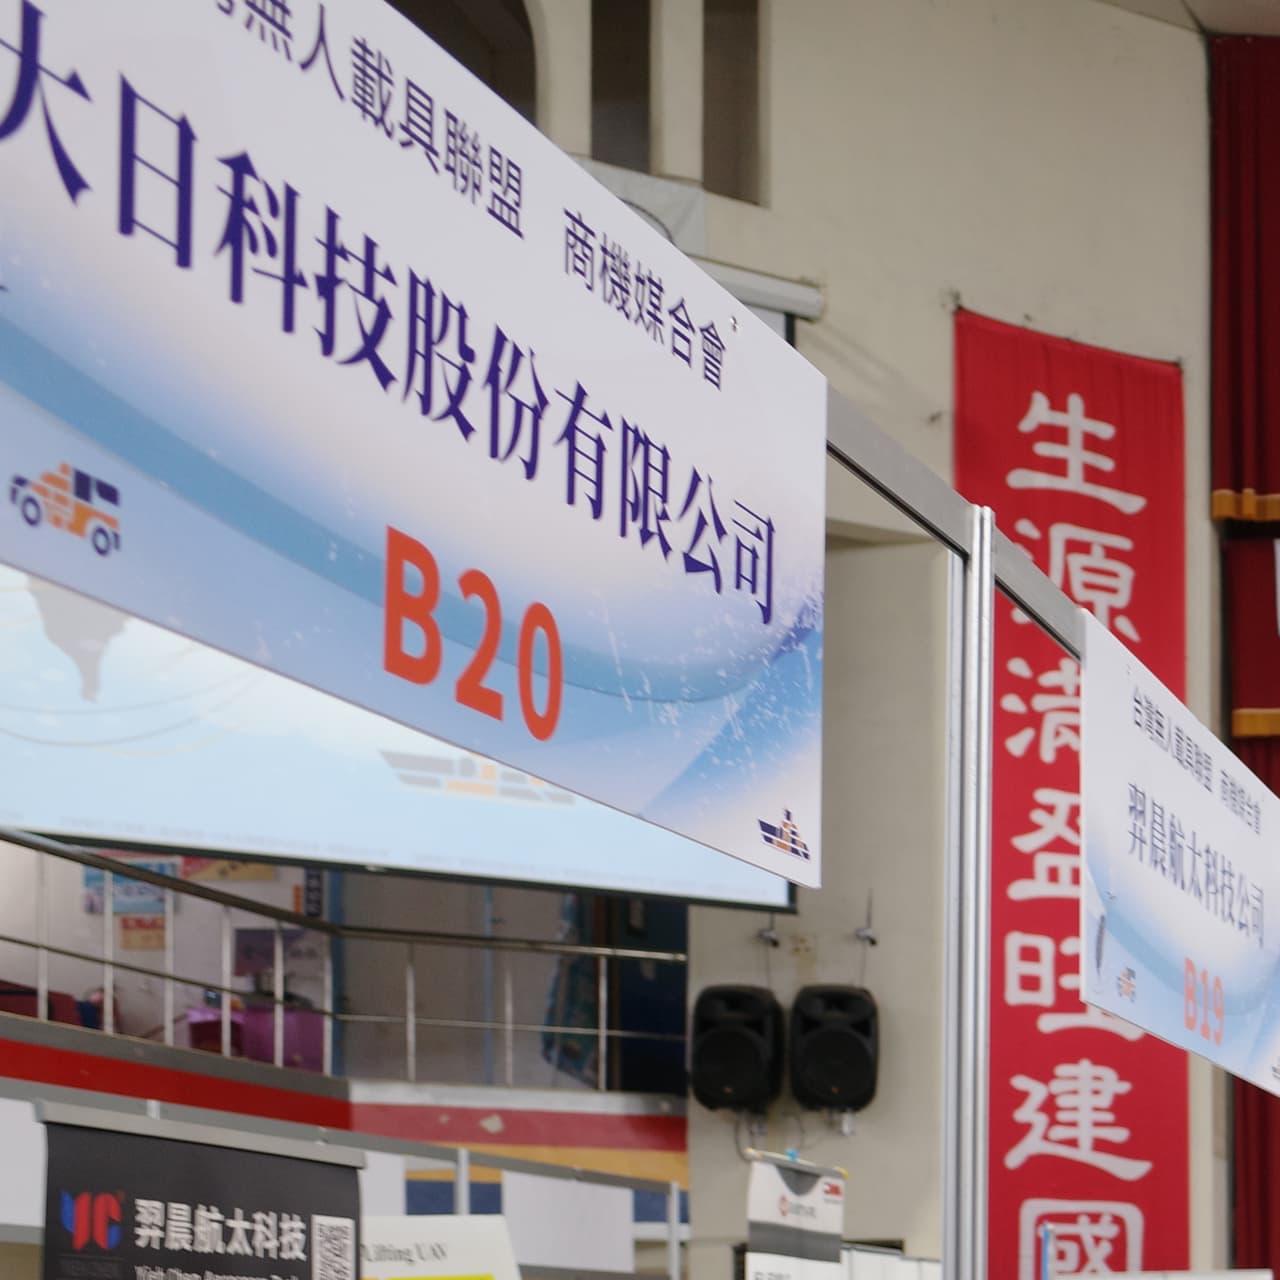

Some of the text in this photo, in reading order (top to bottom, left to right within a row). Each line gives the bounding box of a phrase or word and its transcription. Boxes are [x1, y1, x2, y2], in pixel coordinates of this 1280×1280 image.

[215, 0, 726, 391] 無人載具聯盟 商機媒合會
[0, 0, 777, 625] 大日科技股份有限公司
[382, 525, 564, 742] B20
[1183, 957, 1225, 1047] B19
[134, 1198, 307, 1262] 羿晨航太科技
